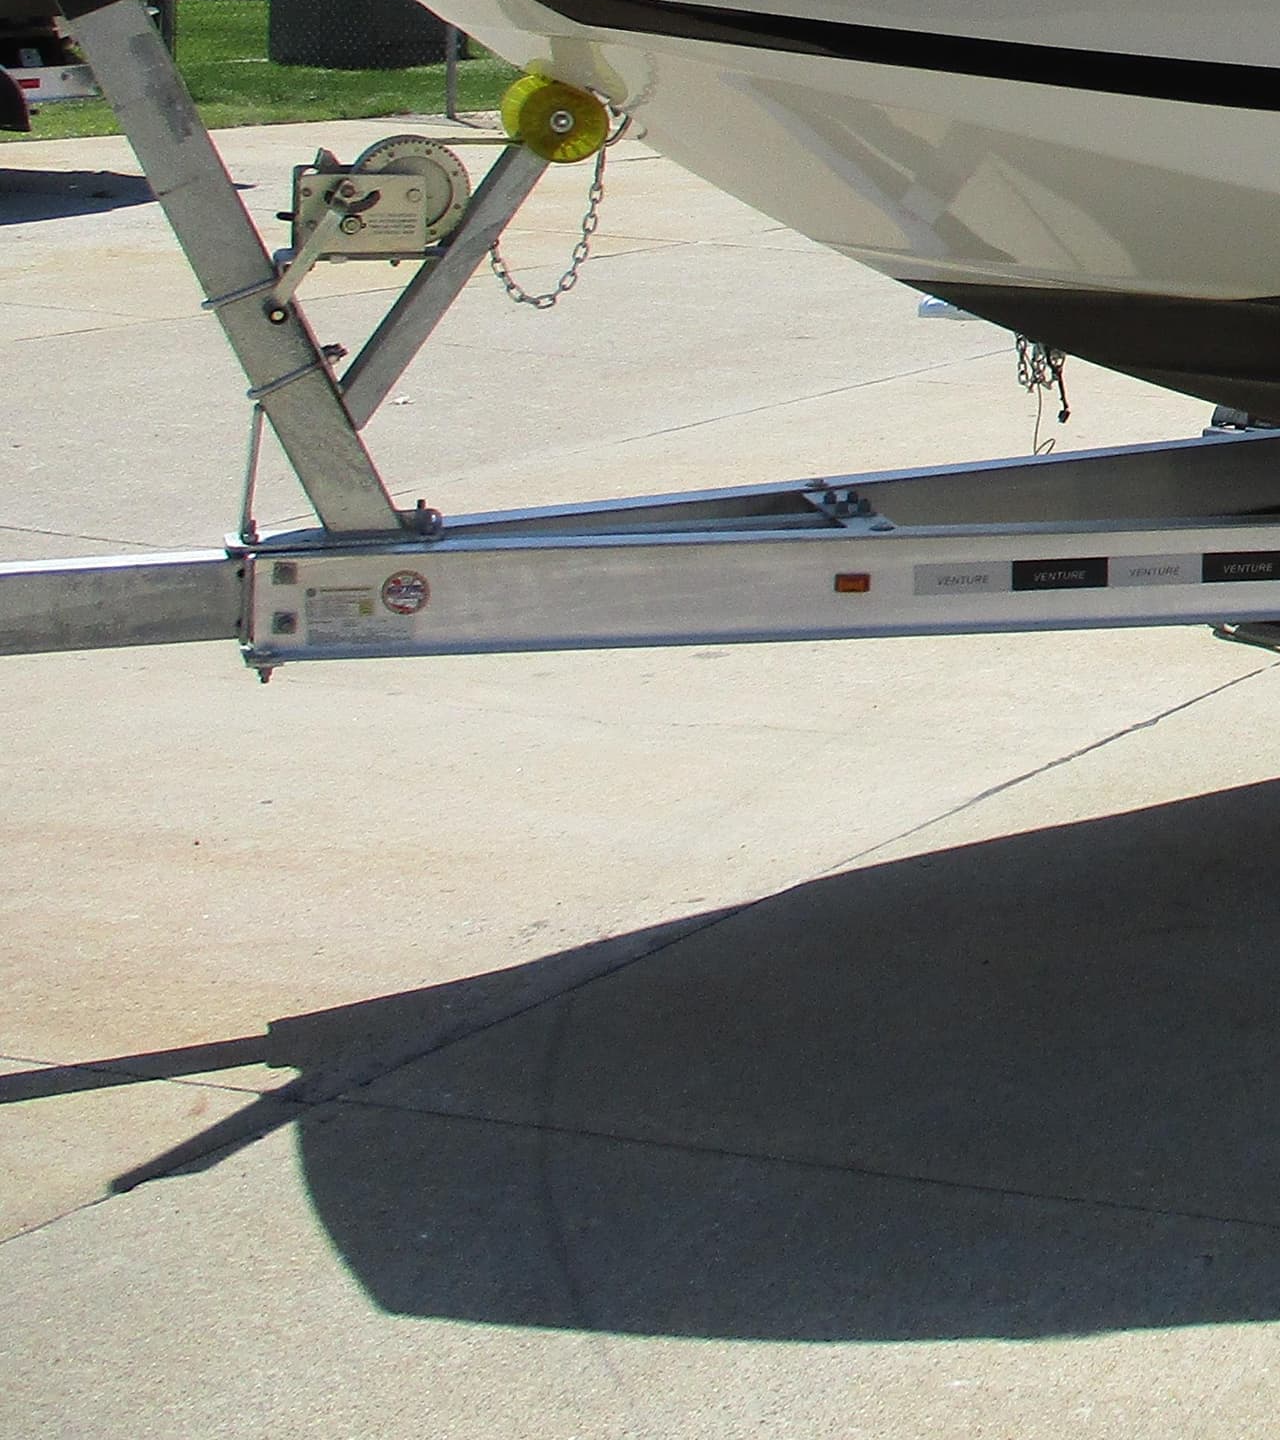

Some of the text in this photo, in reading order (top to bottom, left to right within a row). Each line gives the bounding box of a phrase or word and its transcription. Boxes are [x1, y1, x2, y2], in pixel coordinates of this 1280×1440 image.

[1128, 566, 1181, 577] VENTURE
[1223, 562, 1274, 574] VENTURE
[937, 574, 990, 586] VENTURE
[1033, 570, 1087, 582] VENTURE
